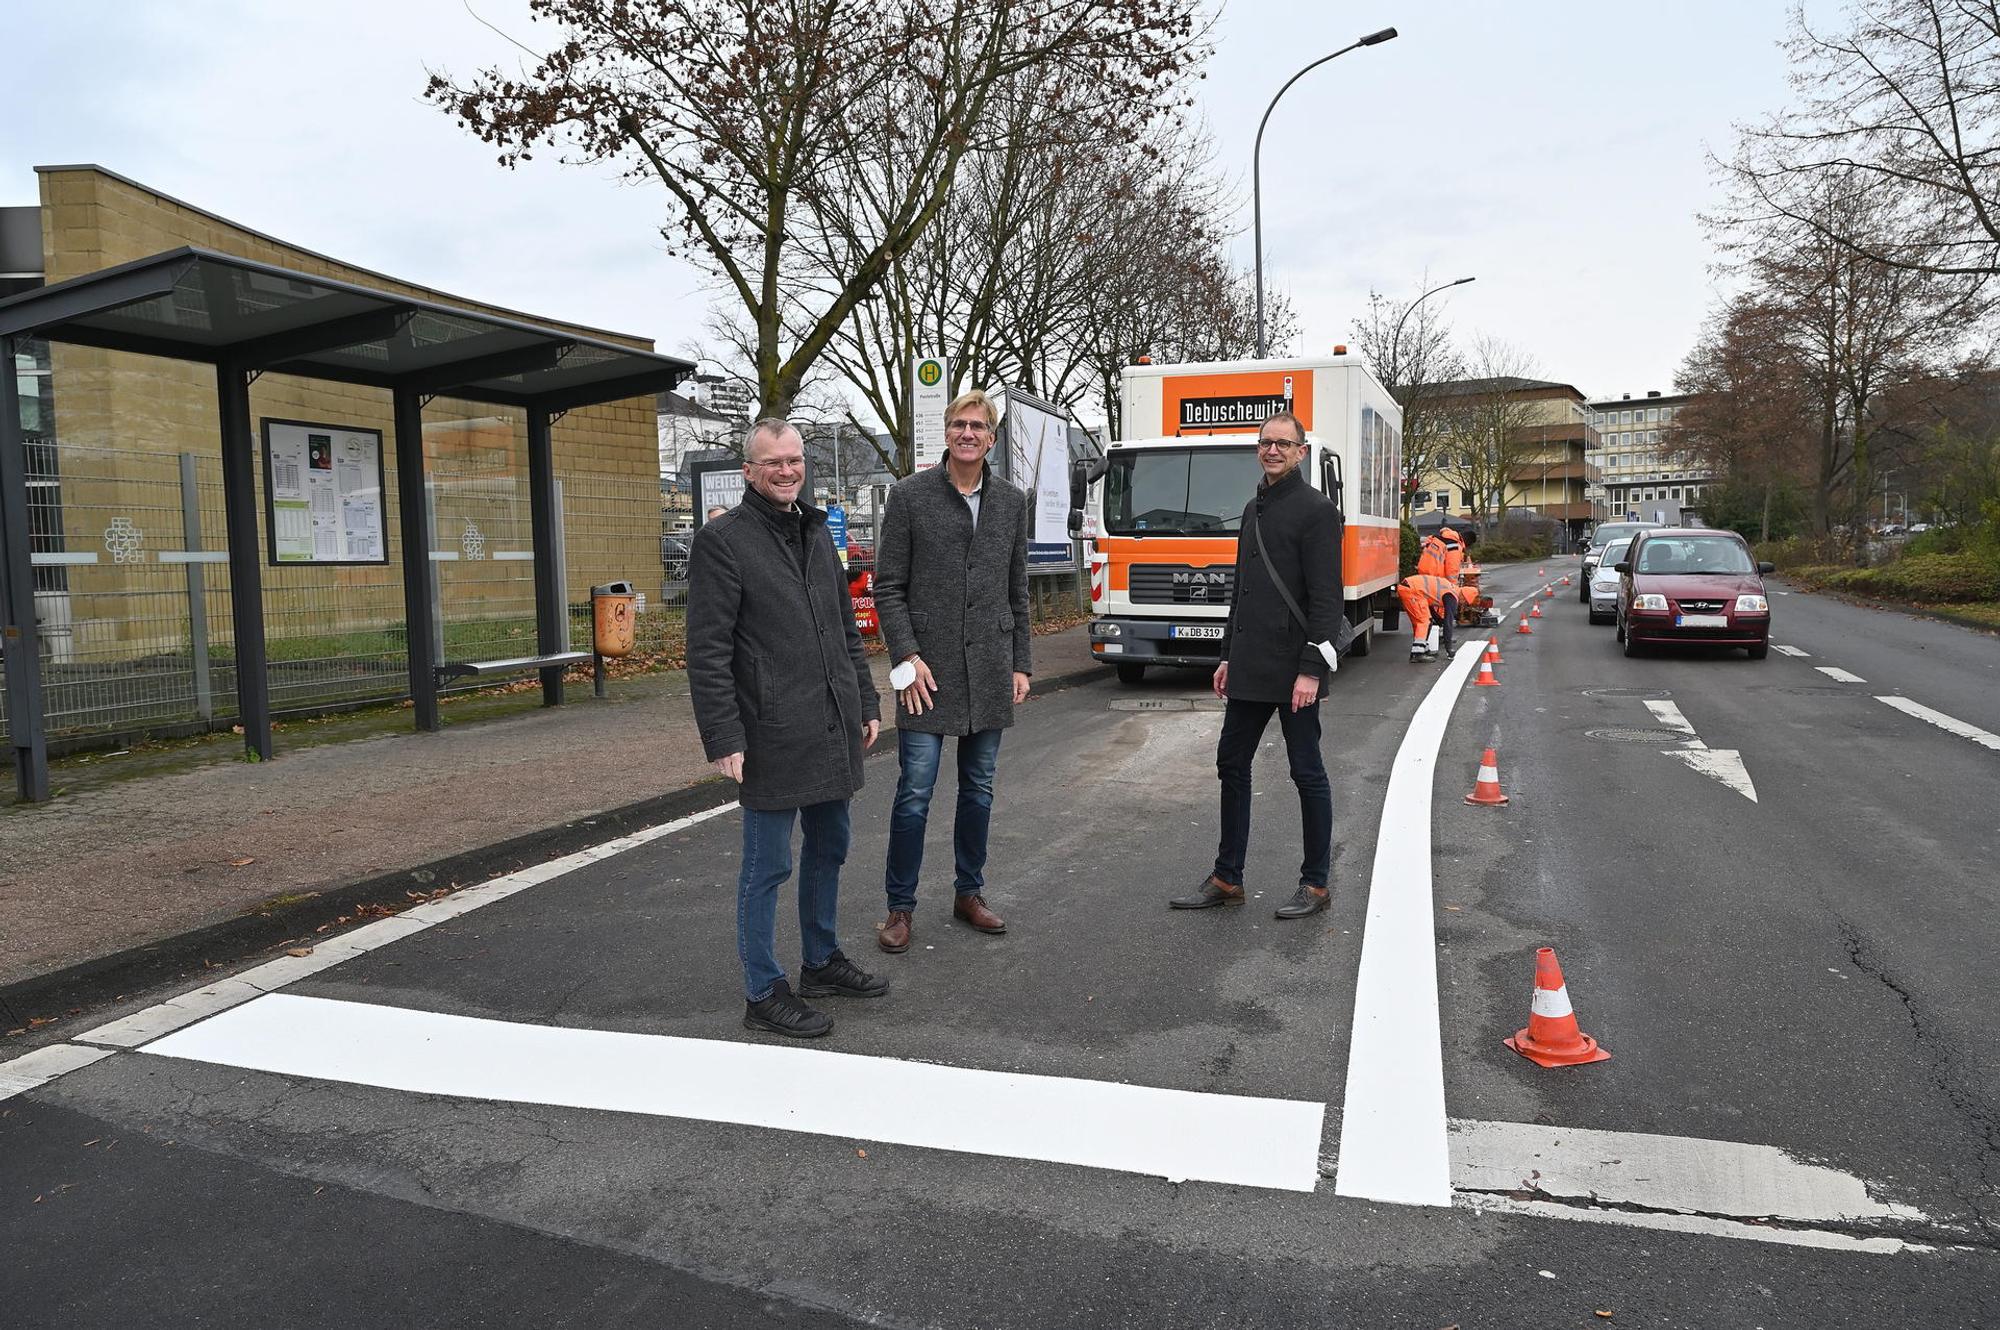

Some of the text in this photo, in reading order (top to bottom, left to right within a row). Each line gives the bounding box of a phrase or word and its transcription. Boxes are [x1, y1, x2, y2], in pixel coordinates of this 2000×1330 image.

[1185, 400, 1285, 423] Debuschewitz
[1173, 573, 1225, 583] MAN
[1178, 628, 1220, 638] K DB 319
